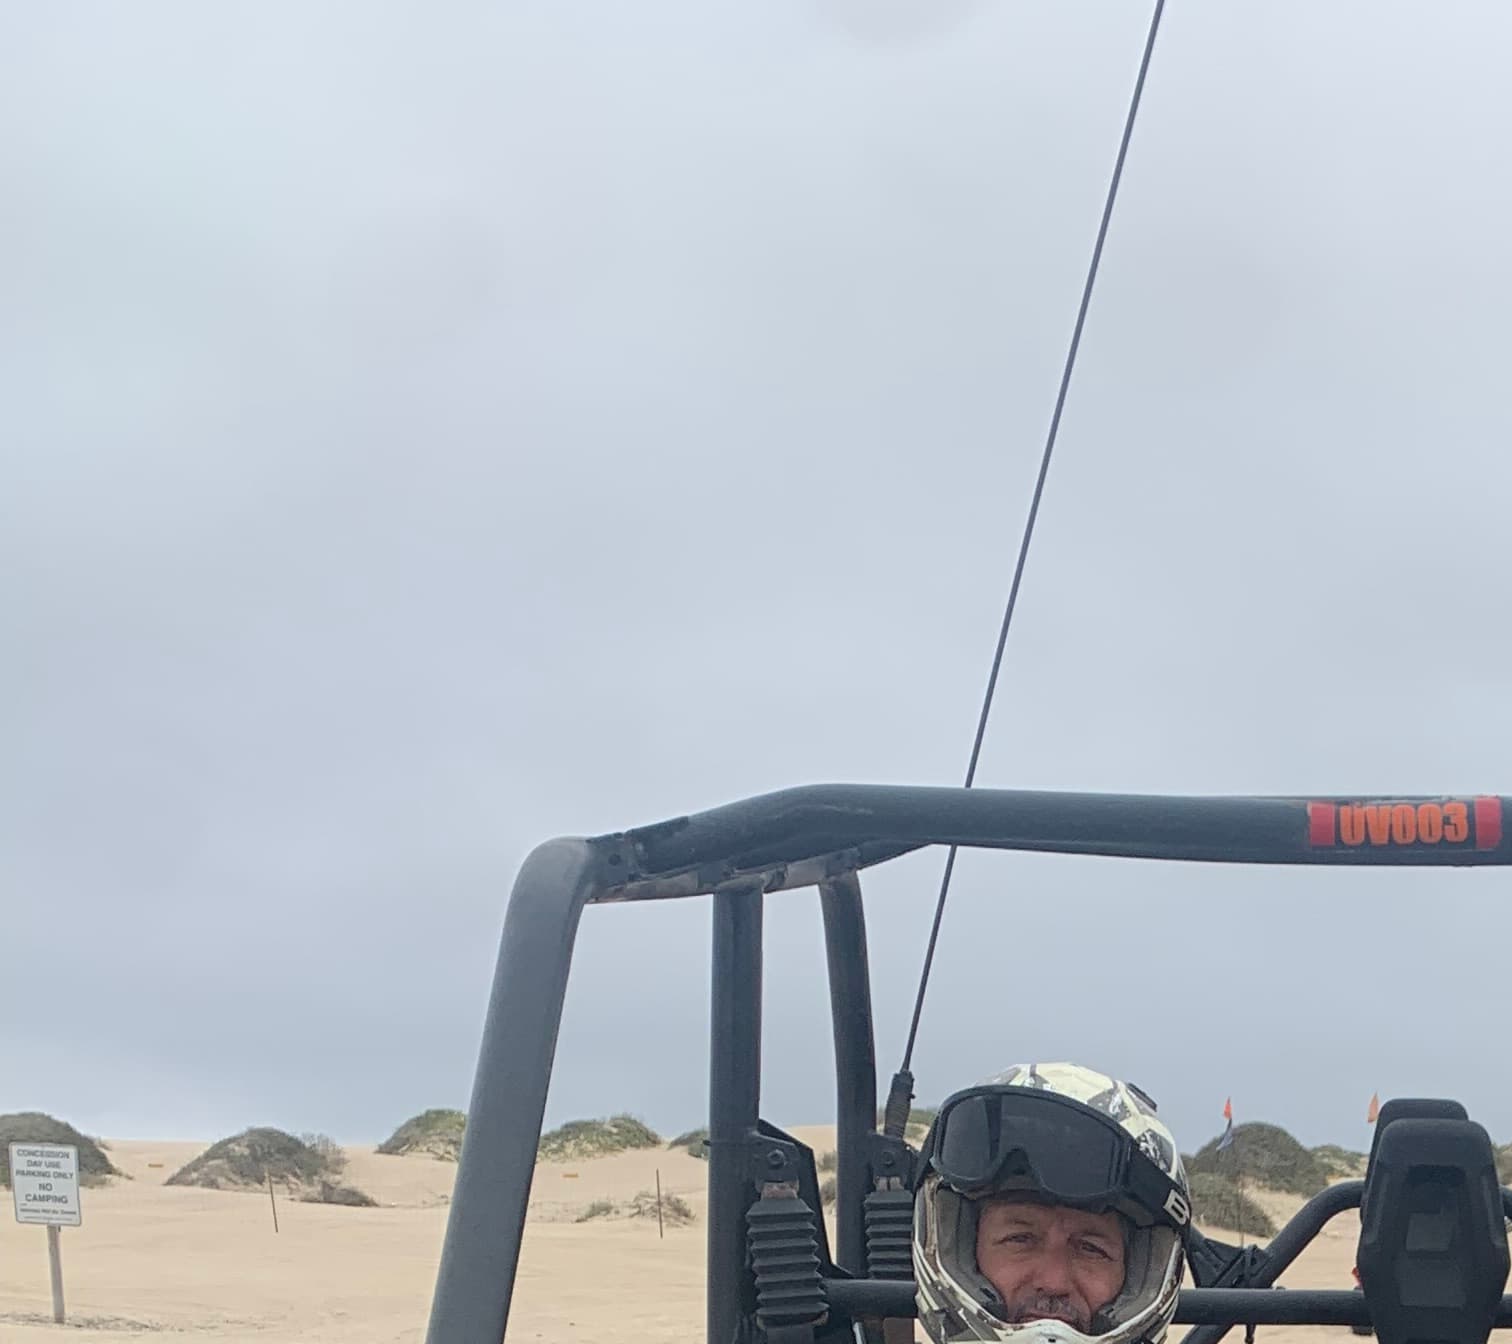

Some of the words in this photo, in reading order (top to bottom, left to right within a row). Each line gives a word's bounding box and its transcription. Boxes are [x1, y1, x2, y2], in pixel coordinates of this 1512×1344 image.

[16, 1149, 70, 1159] CONCESSION
[27, 1160, 43, 1168] DAY
[16, 1170, 51, 1178] PARKING
[53, 1171, 73, 1179] ONLY
[39, 1183, 53, 1191] NO
[25, 1193, 68, 1204] CAMPING
